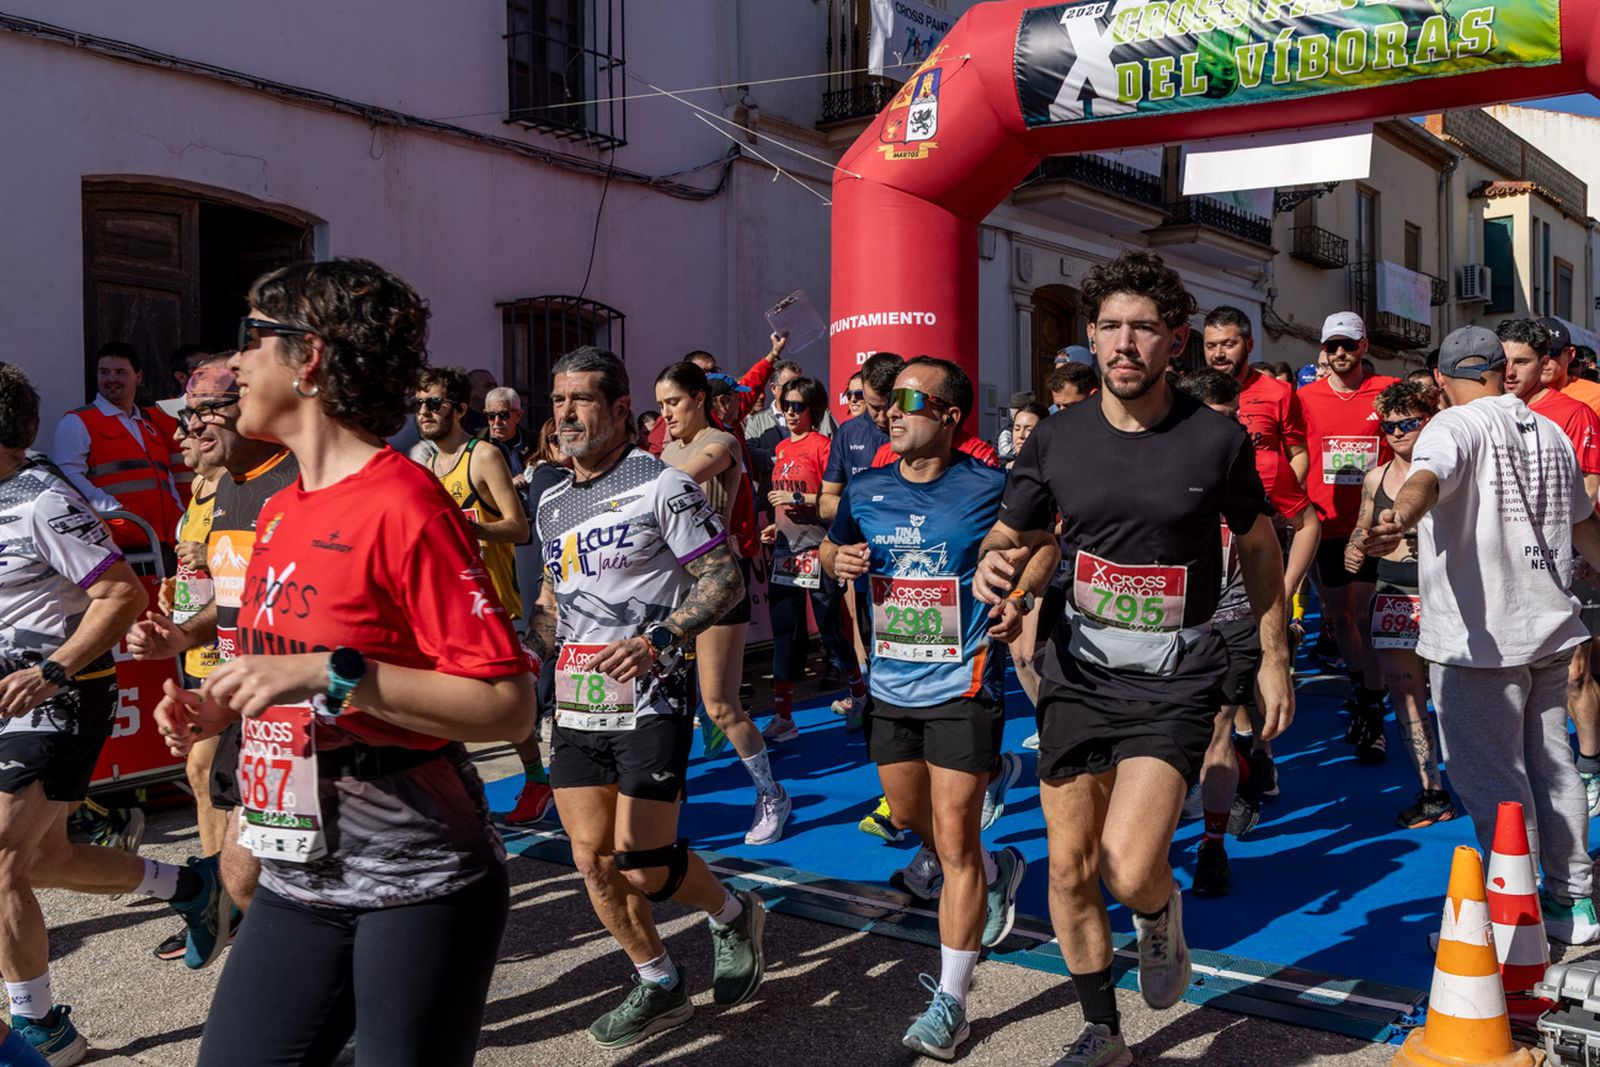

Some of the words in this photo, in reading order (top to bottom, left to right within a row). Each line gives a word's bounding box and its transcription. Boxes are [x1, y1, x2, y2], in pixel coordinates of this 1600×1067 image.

[895, 2, 924, 25] CROSS
[1066, 5, 1104, 20] 2026
[1115, 53, 1208, 104] DEL
[1235, 7, 1495, 89] VÍBORAS
[893, 150, 919, 159] MARTOS
[830, 311, 937, 337] YUNTAMIENTO
[1332, 453, 1366, 470] 651
[596, 552, 633, 582] Jaén
[1092, 561, 1108, 581] X
[1110, 573, 1166, 588] CROSS
[882, 580, 896, 598] X
[896, 587, 942, 600] CROSS
[1091, 577, 1152, 598] PANTANO
[884, 597, 931, 609] PANTANO
[1093, 588, 1165, 625] 795
[885, 605, 943, 635] 290
[566, 648, 576, 664] X
[571, 674, 606, 704] 78
[242, 755, 292, 812] 587
